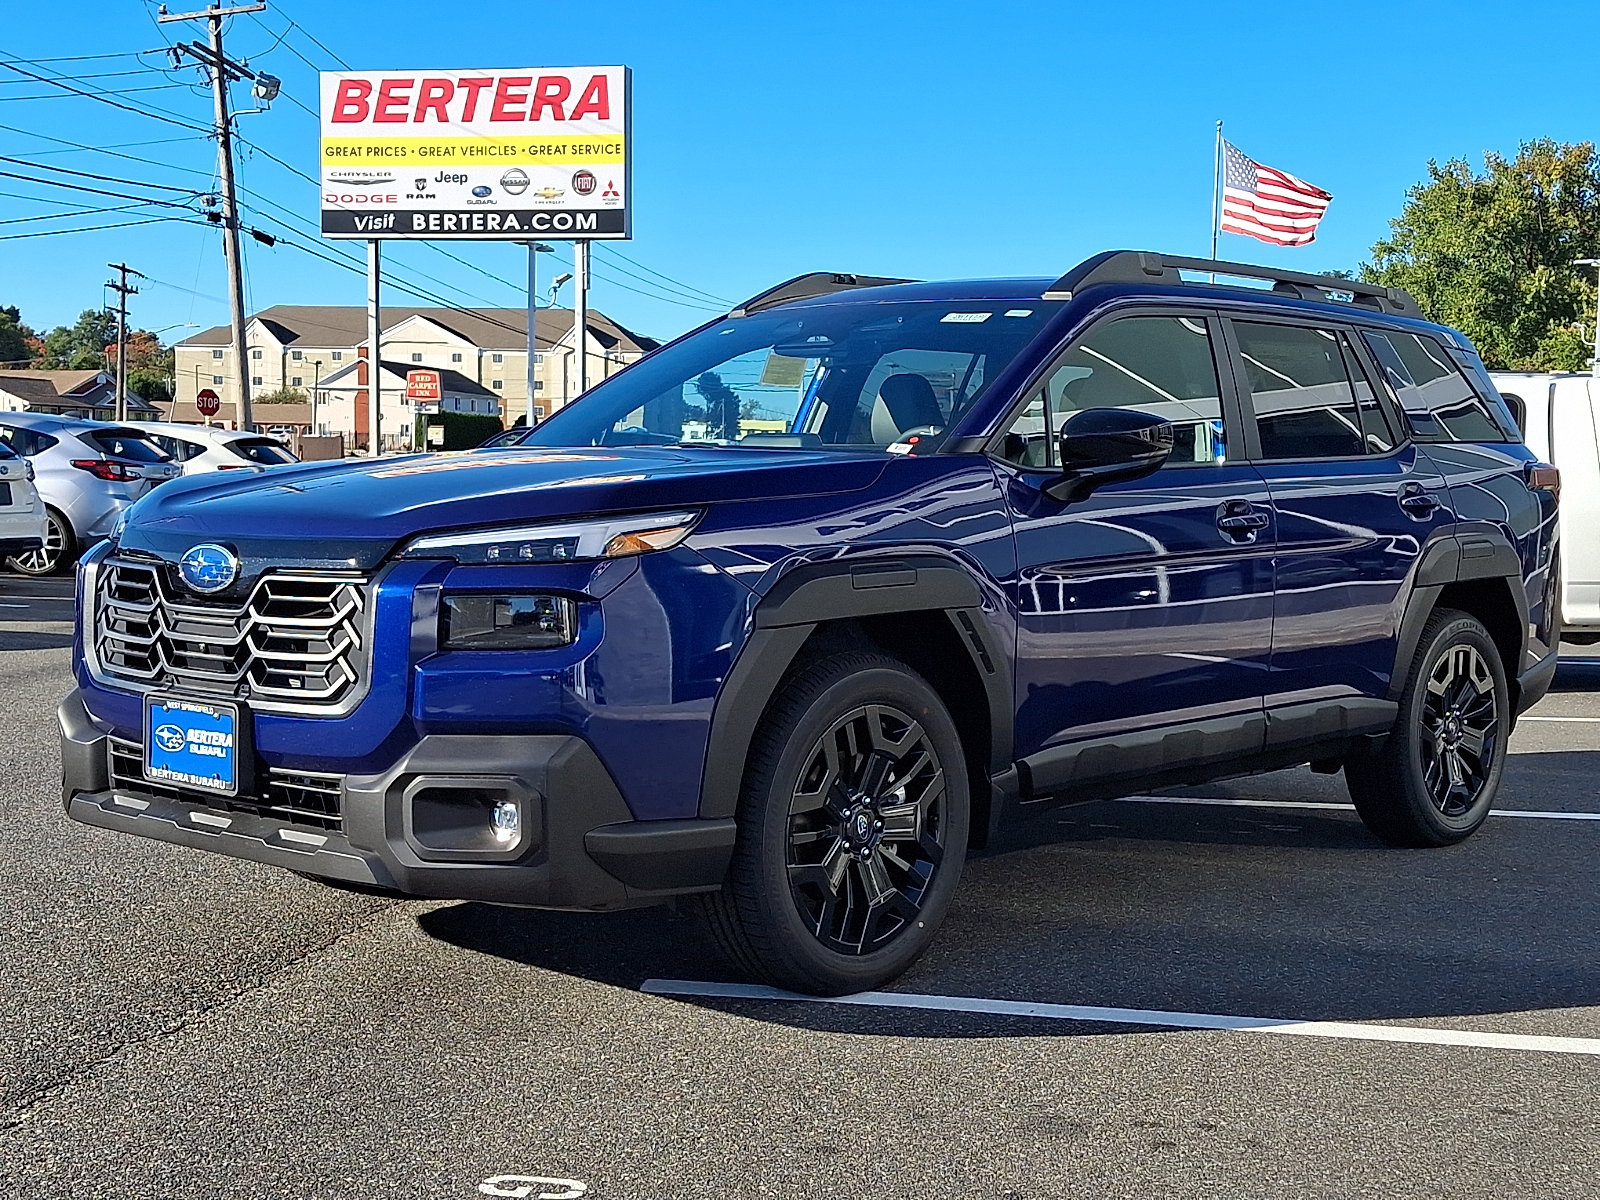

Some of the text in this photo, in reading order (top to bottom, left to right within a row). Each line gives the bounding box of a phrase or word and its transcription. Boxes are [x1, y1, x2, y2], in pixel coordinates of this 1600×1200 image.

[331, 75, 611, 123] BERTERA
[325, 143, 621, 158] GREAT PRICES GREAT VEHICLES GREAT SERVICE
[434, 171, 468, 185] Jeep
[578, 177, 594, 189] FIAT
[325, 194, 398, 203] DODGE
[354, 213, 597, 231] Visit BERTERA.COM
[409, 382, 437, 390] CARPET
[197, 396, 219, 409] STOP
[186, 729, 232, 748] BERTERA
[189, 744, 227, 758] SUBARU
[152, 768, 226, 789] BERTERA SUBARU
